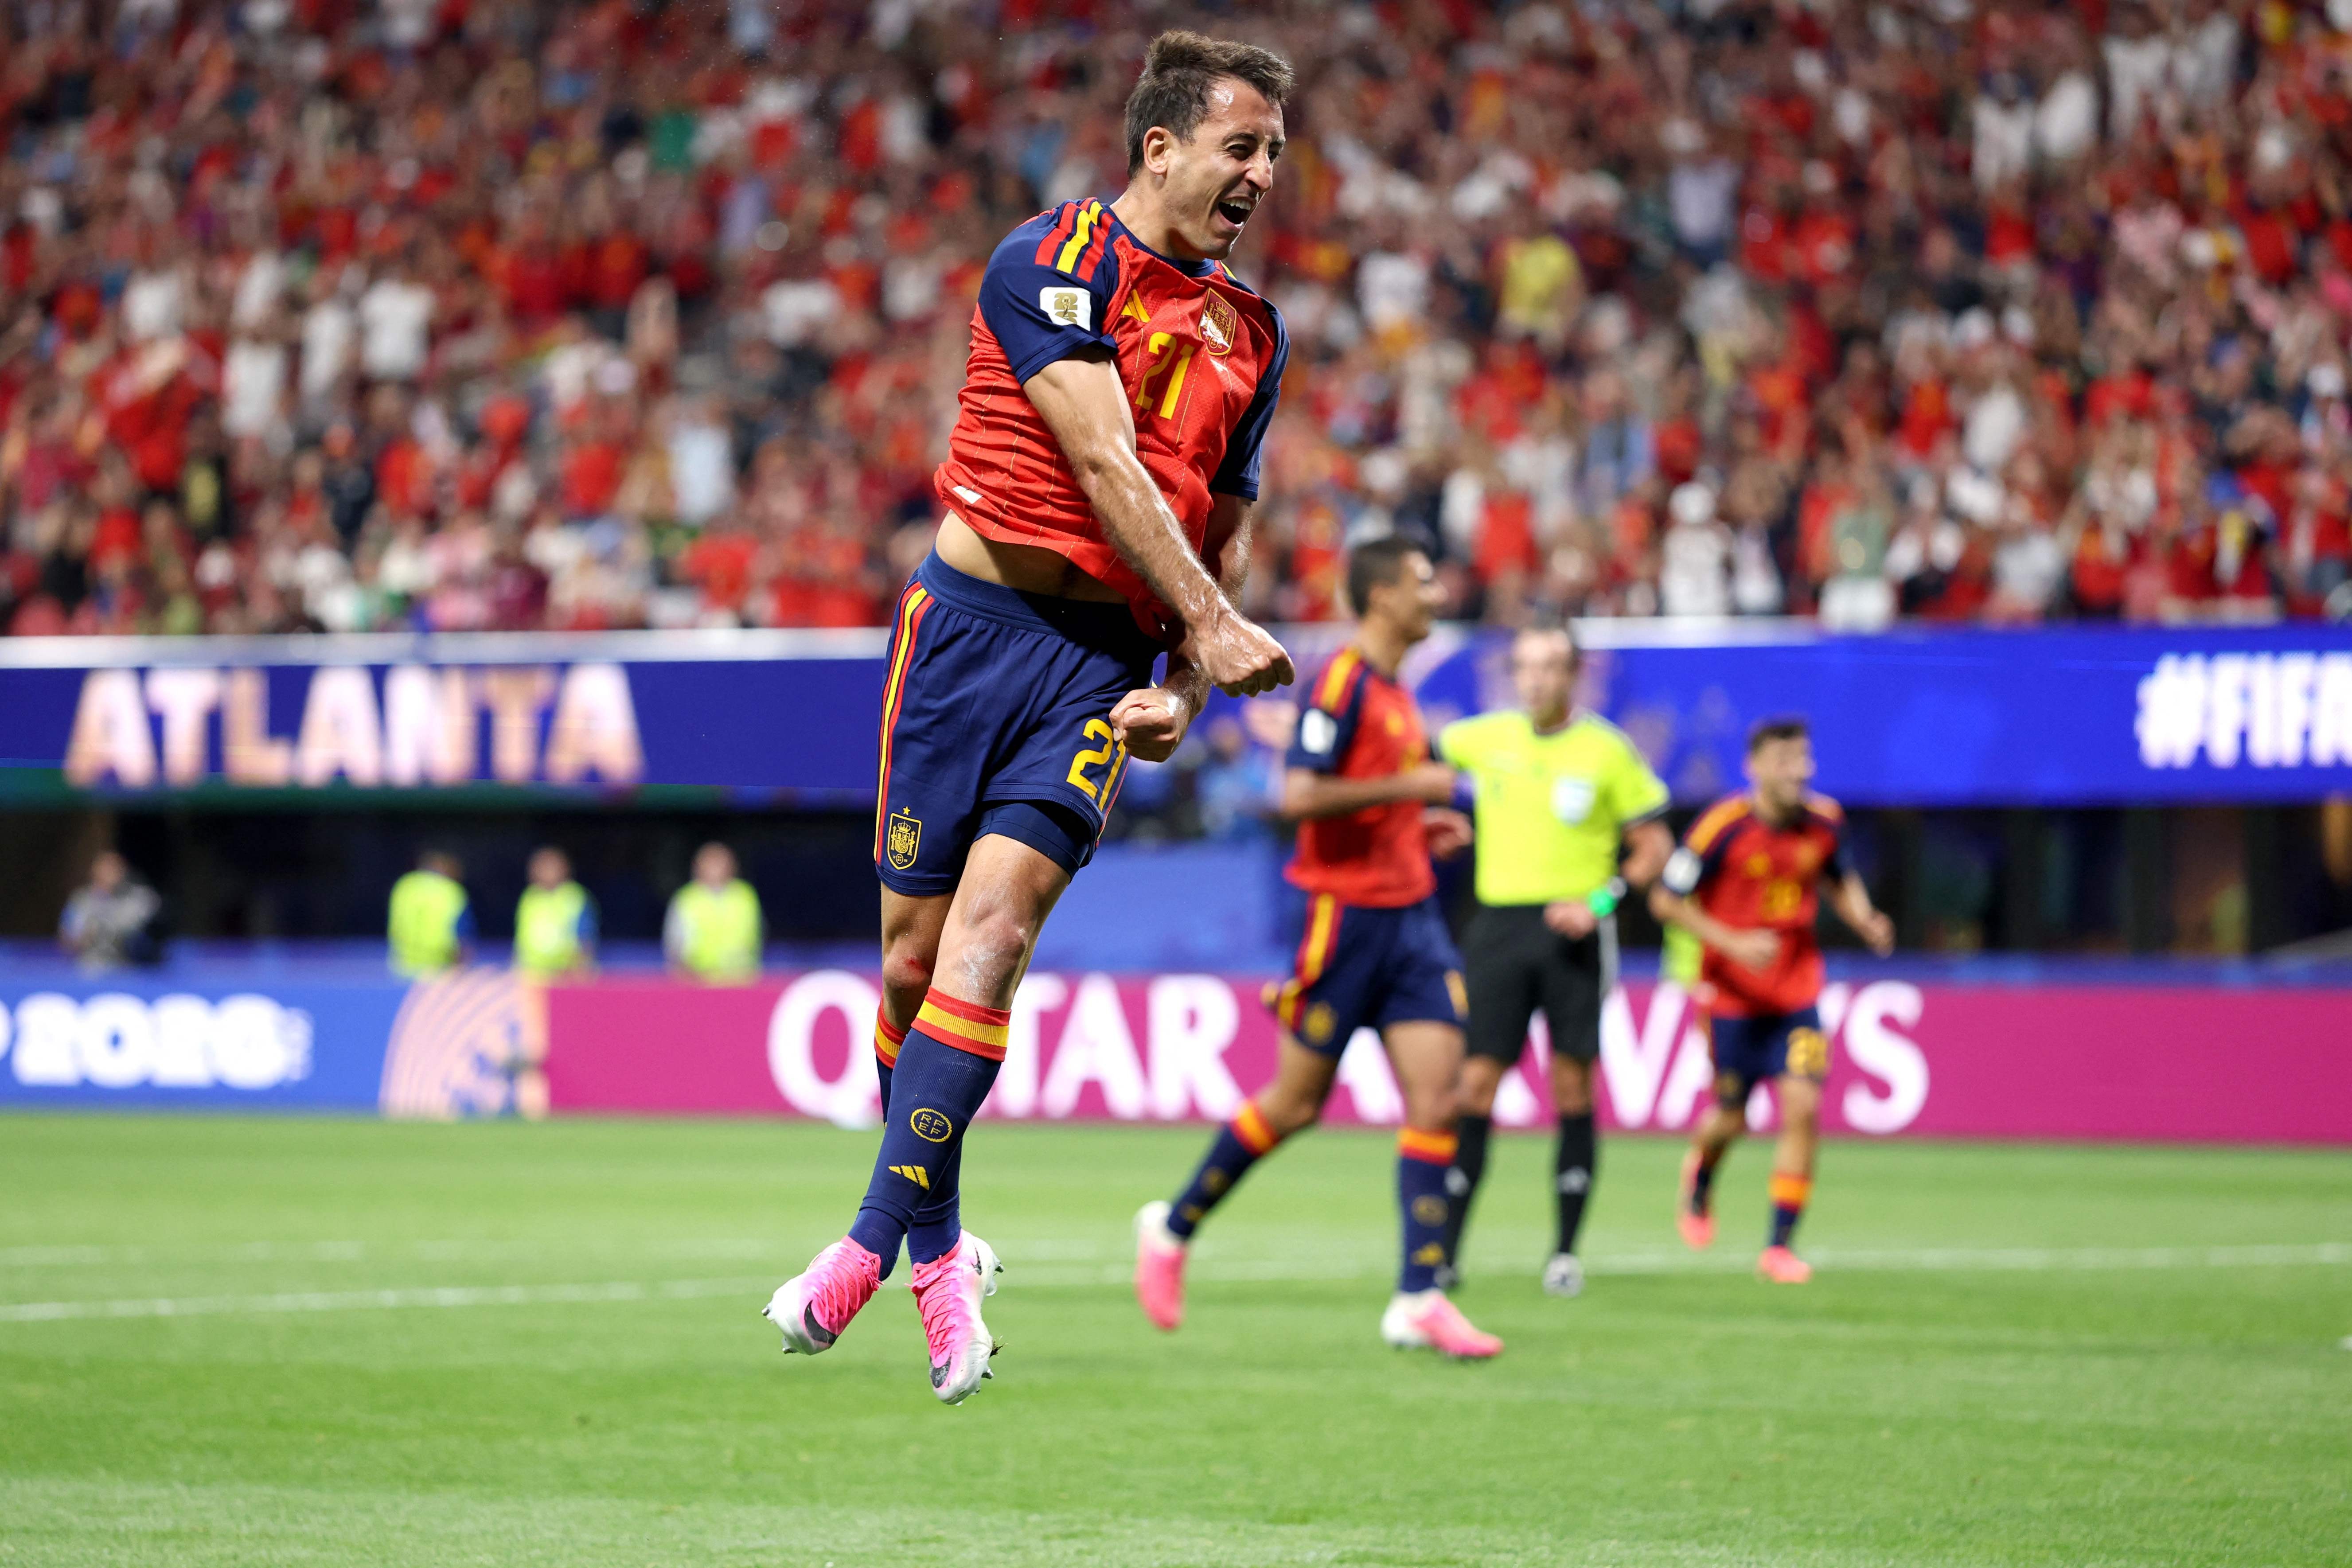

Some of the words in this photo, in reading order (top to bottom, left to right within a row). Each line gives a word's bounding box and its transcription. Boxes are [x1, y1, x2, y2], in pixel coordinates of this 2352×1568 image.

[1134, 331, 1196, 421] 21
[64, 665, 643, 787] ATLANTA
[1065, 718, 1127, 812] 21
[14, 994, 286, 1088] 2026
[767, 969, 1259, 1130] QTAR
